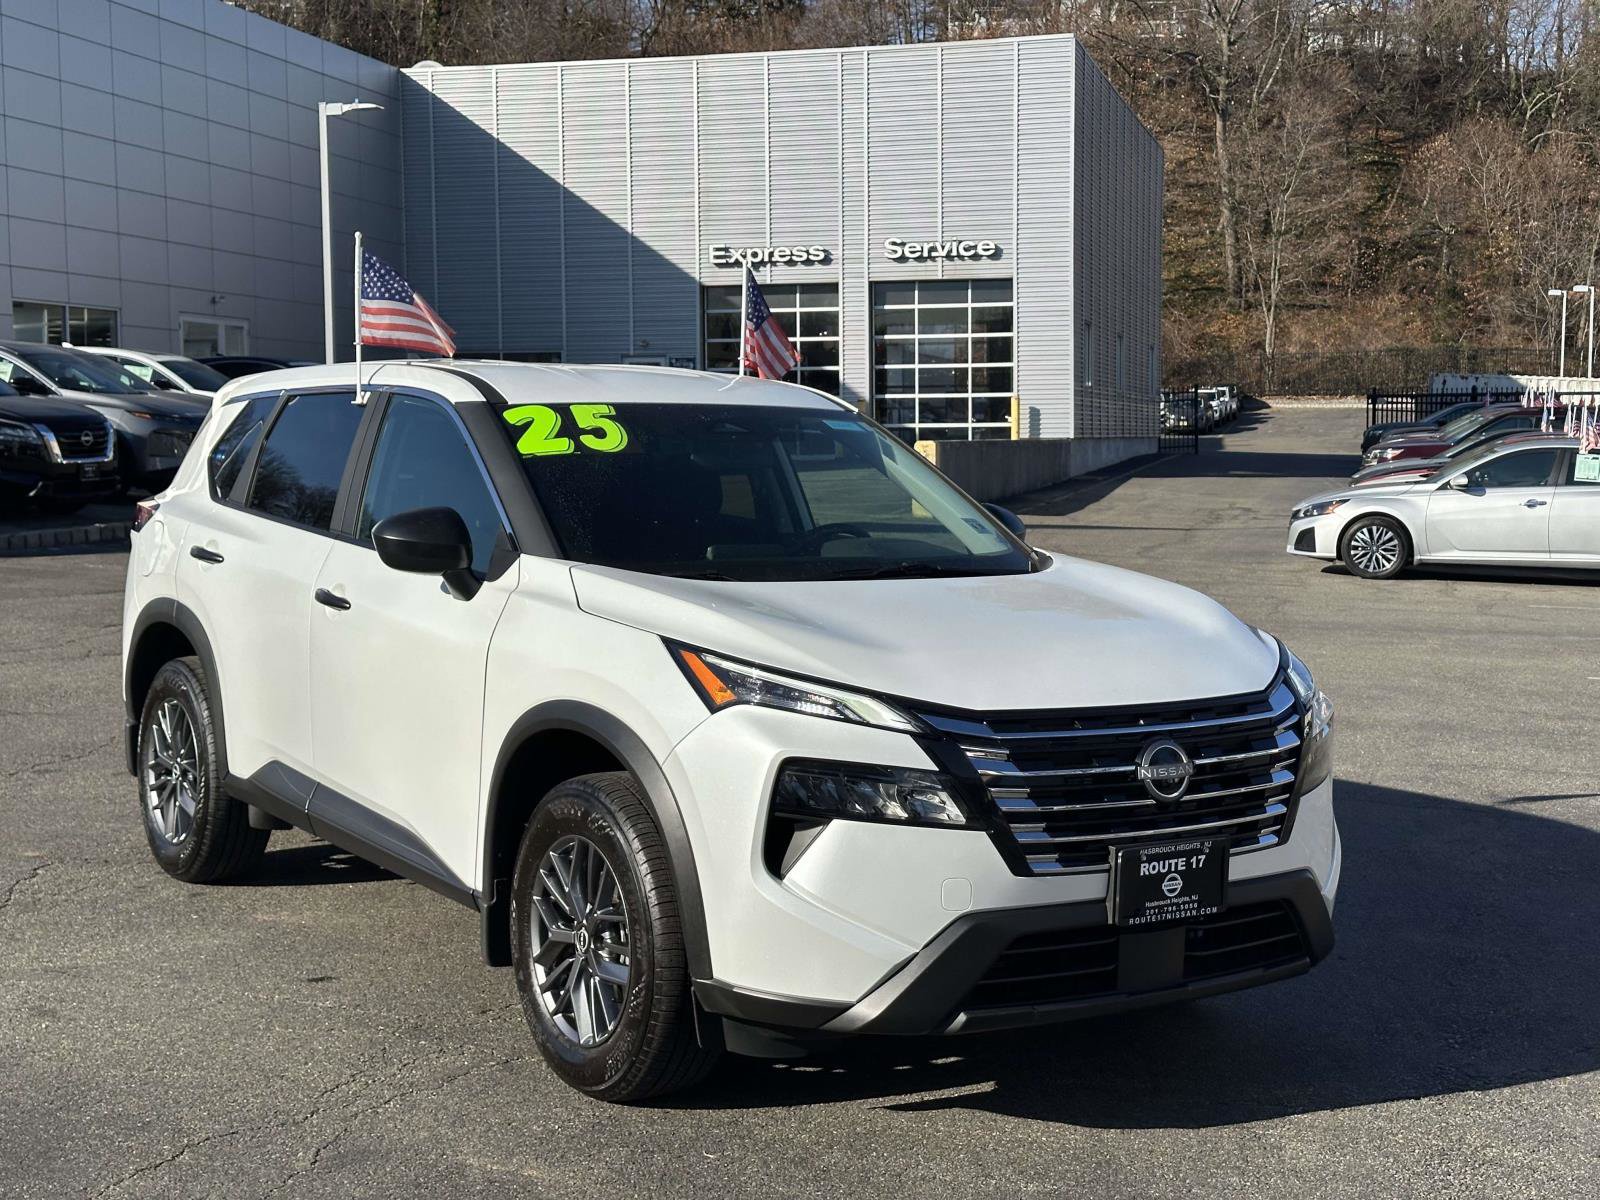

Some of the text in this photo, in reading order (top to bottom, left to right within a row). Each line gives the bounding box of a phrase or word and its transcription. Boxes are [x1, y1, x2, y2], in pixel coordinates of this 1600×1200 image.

[708, 236, 998, 264] Express Service
[502, 404, 629, 457] 25
[1141, 765, 1193, 778] NISSAN
[1140, 845, 1175, 855] HASBROUCK
[1140, 855, 1206, 876] ROUTE 17
[1145, 898, 1171, 908] Hasbrouck
[1129, 907, 1218, 925] ROUTE17NISSAN.COM
